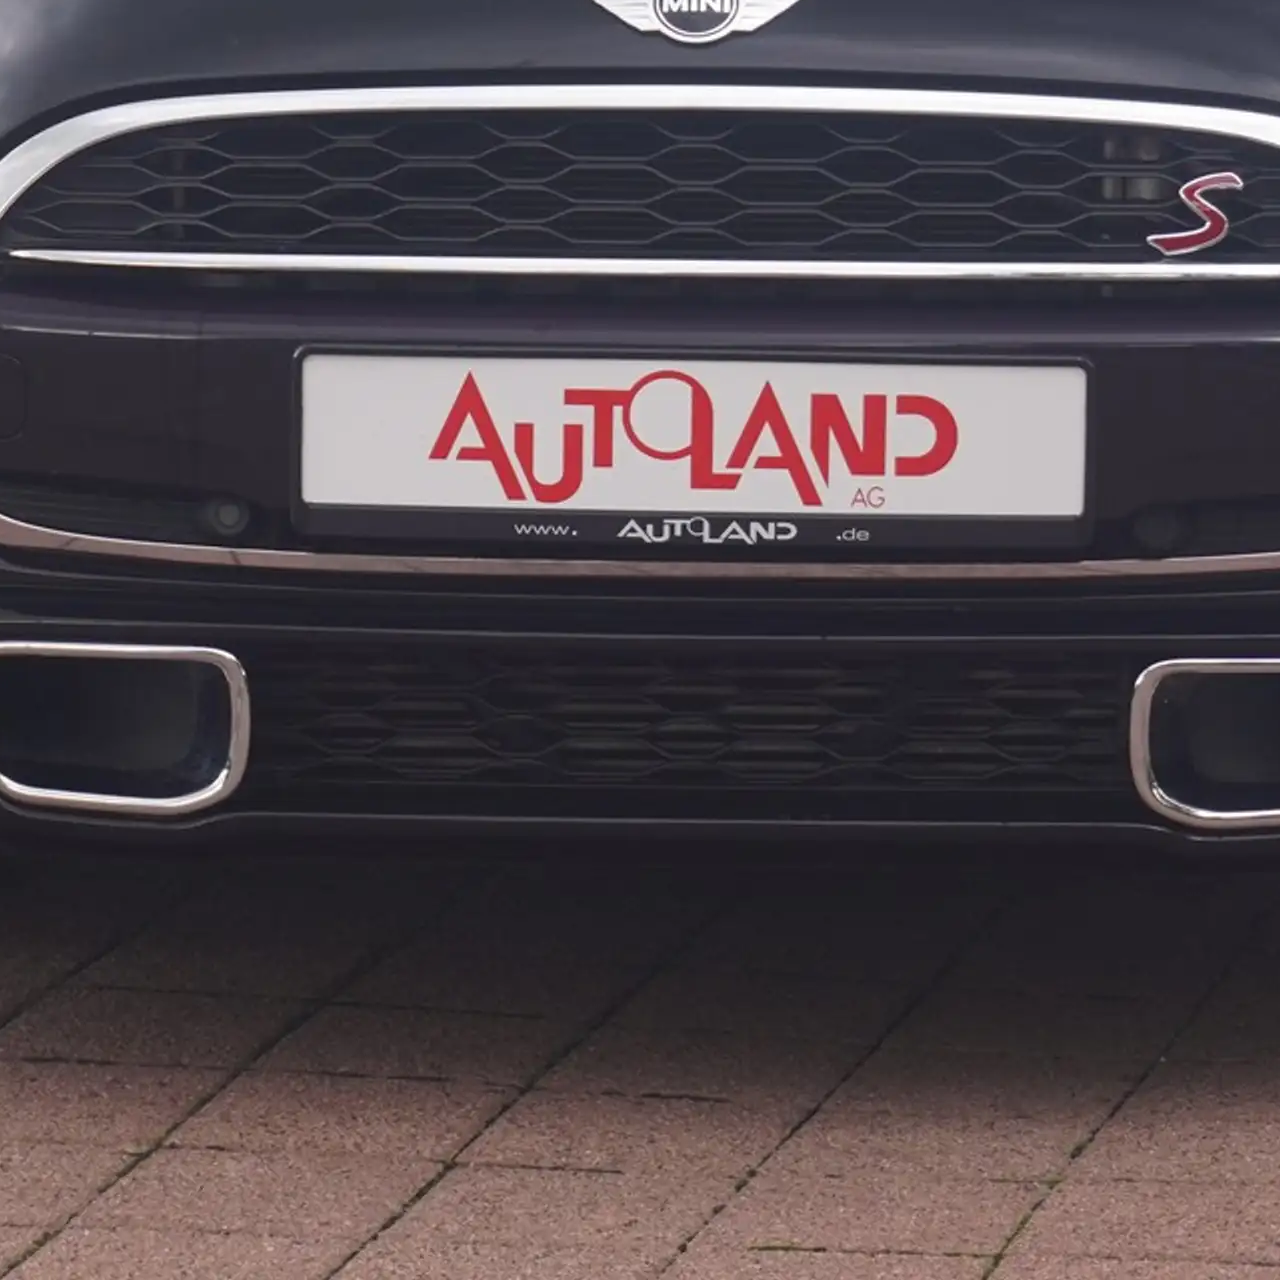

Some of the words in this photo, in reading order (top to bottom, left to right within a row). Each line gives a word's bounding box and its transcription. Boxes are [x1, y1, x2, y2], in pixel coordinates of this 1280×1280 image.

[1146, 171, 1244, 257] S
[428, 369, 959, 507] AUTOLAND
[850, 485, 886, 510] AG
[513, 523, 579, 537] www.
[616, 516, 799, 546] AUTOLAND
[835, 527, 871, 542] .de
